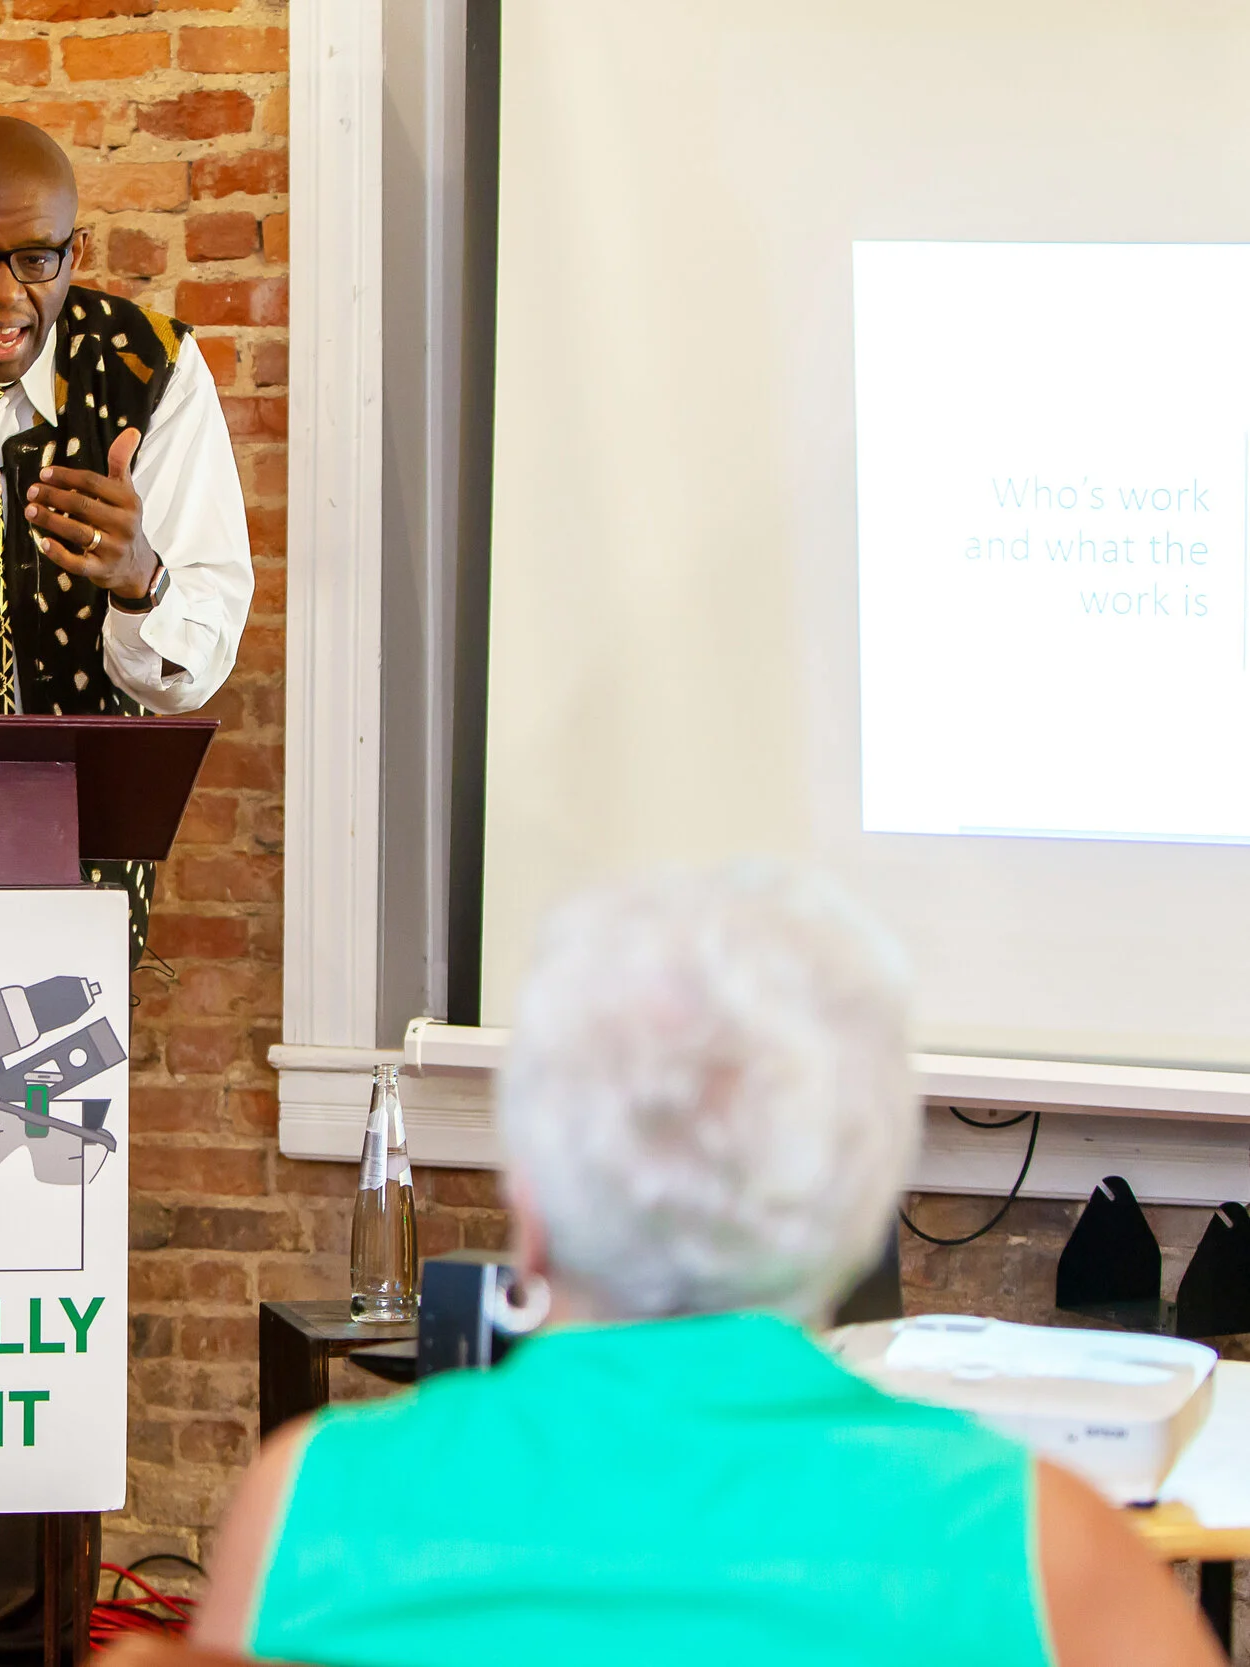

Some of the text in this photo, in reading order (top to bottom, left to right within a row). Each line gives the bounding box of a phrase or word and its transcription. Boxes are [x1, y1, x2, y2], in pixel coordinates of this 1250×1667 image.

[991, 474, 1210, 513] Who's work
[964, 528, 1209, 566] and what the
[1079, 581, 1209, 617] work is
